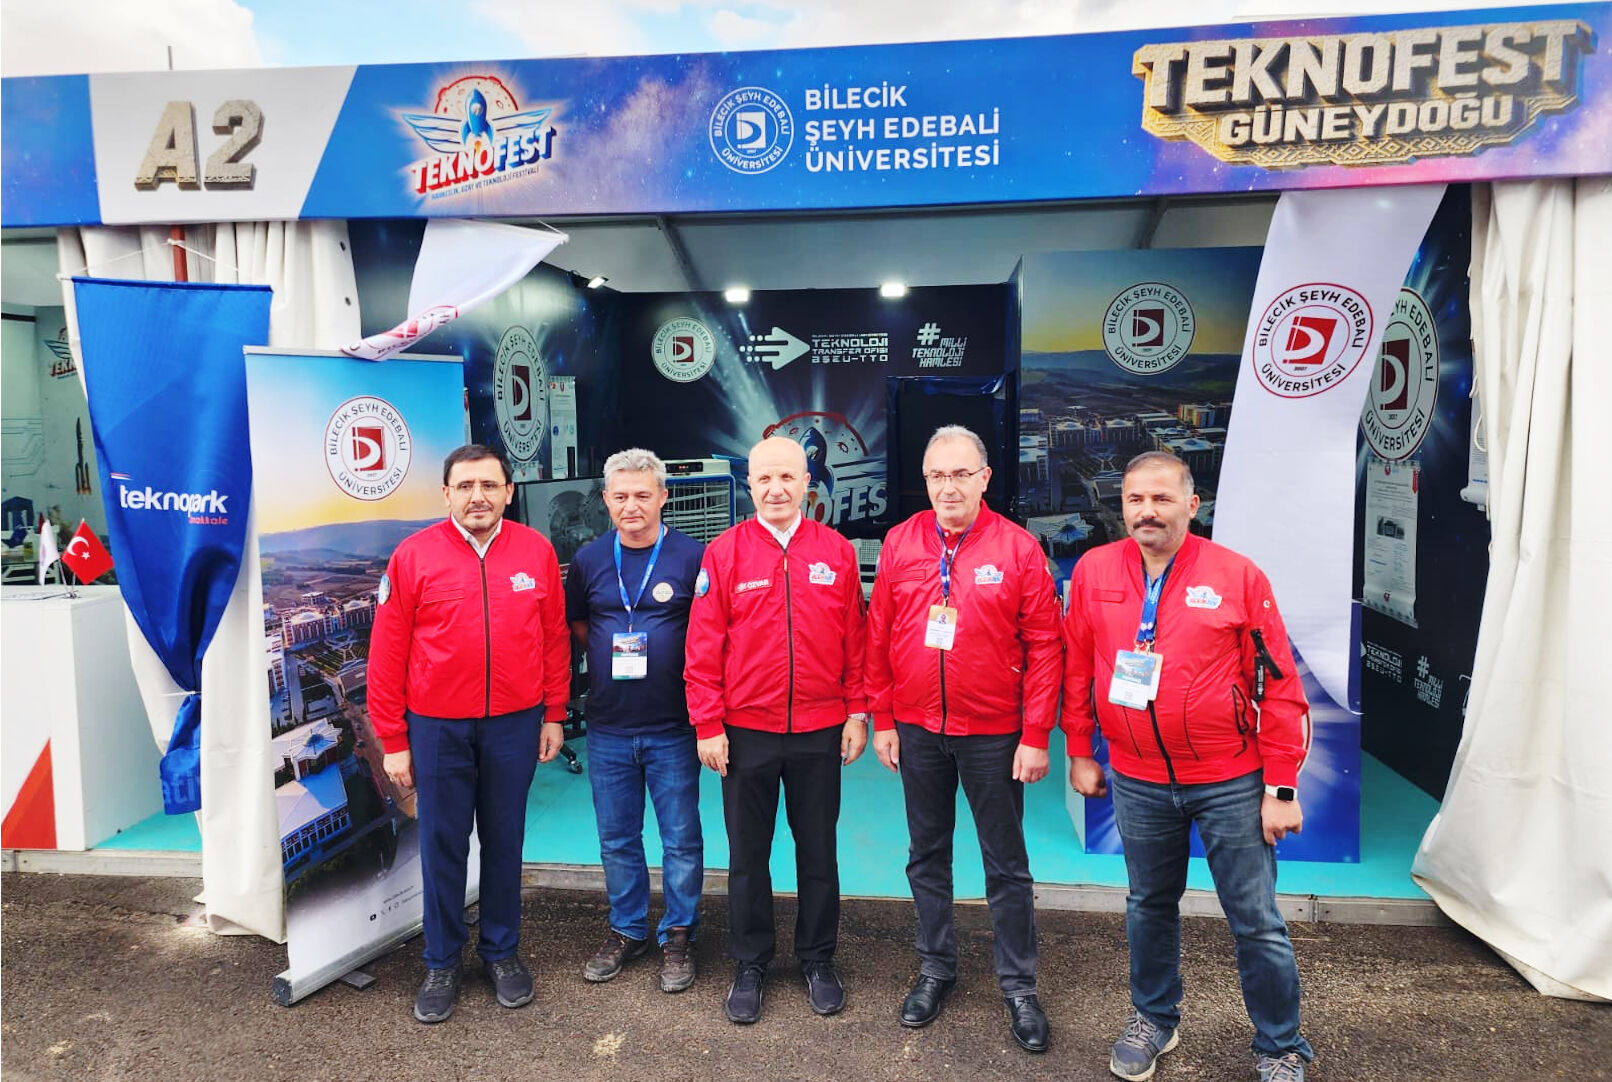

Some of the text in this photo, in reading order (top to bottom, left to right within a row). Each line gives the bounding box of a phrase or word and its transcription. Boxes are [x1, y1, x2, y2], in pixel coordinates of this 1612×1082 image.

[1138, 20, 1592, 112] TEKNOFEST
[805, 81, 907, 111] BİLECİK
[804, 107, 1000, 147] ŞEYH EDEBALİ
[1218, 93, 1515, 147] GÜNEYDOĞU
[134, 99, 266, 191] A2
[411, 125, 557, 195] TEKNOFEST
[805, 139, 1000, 173] ÜNİVERSİTESİ
[1106, 295, 1132, 334] BİLECİK
[1163, 291, 1192, 333] EDEBALİ
[1258, 290, 1366, 348] BİLECİK ŞEYH EDEBALİ
[1114, 344, 1183, 369] ÜNİVERSİTESİ
[1409, 304, 1435, 382] EDEBALİ
[1261, 363, 1347, 392] ÜNİVERSİTESİ
[328, 410, 351, 455] BİLECİK
[351, 402, 379, 415] ŞEYH
[1365, 407, 1426, 451] ÜNİVERSİTESİ
[120, 484, 229, 518] teknopark
[338, 466, 404, 496] ÜNİVERSİTESİ
